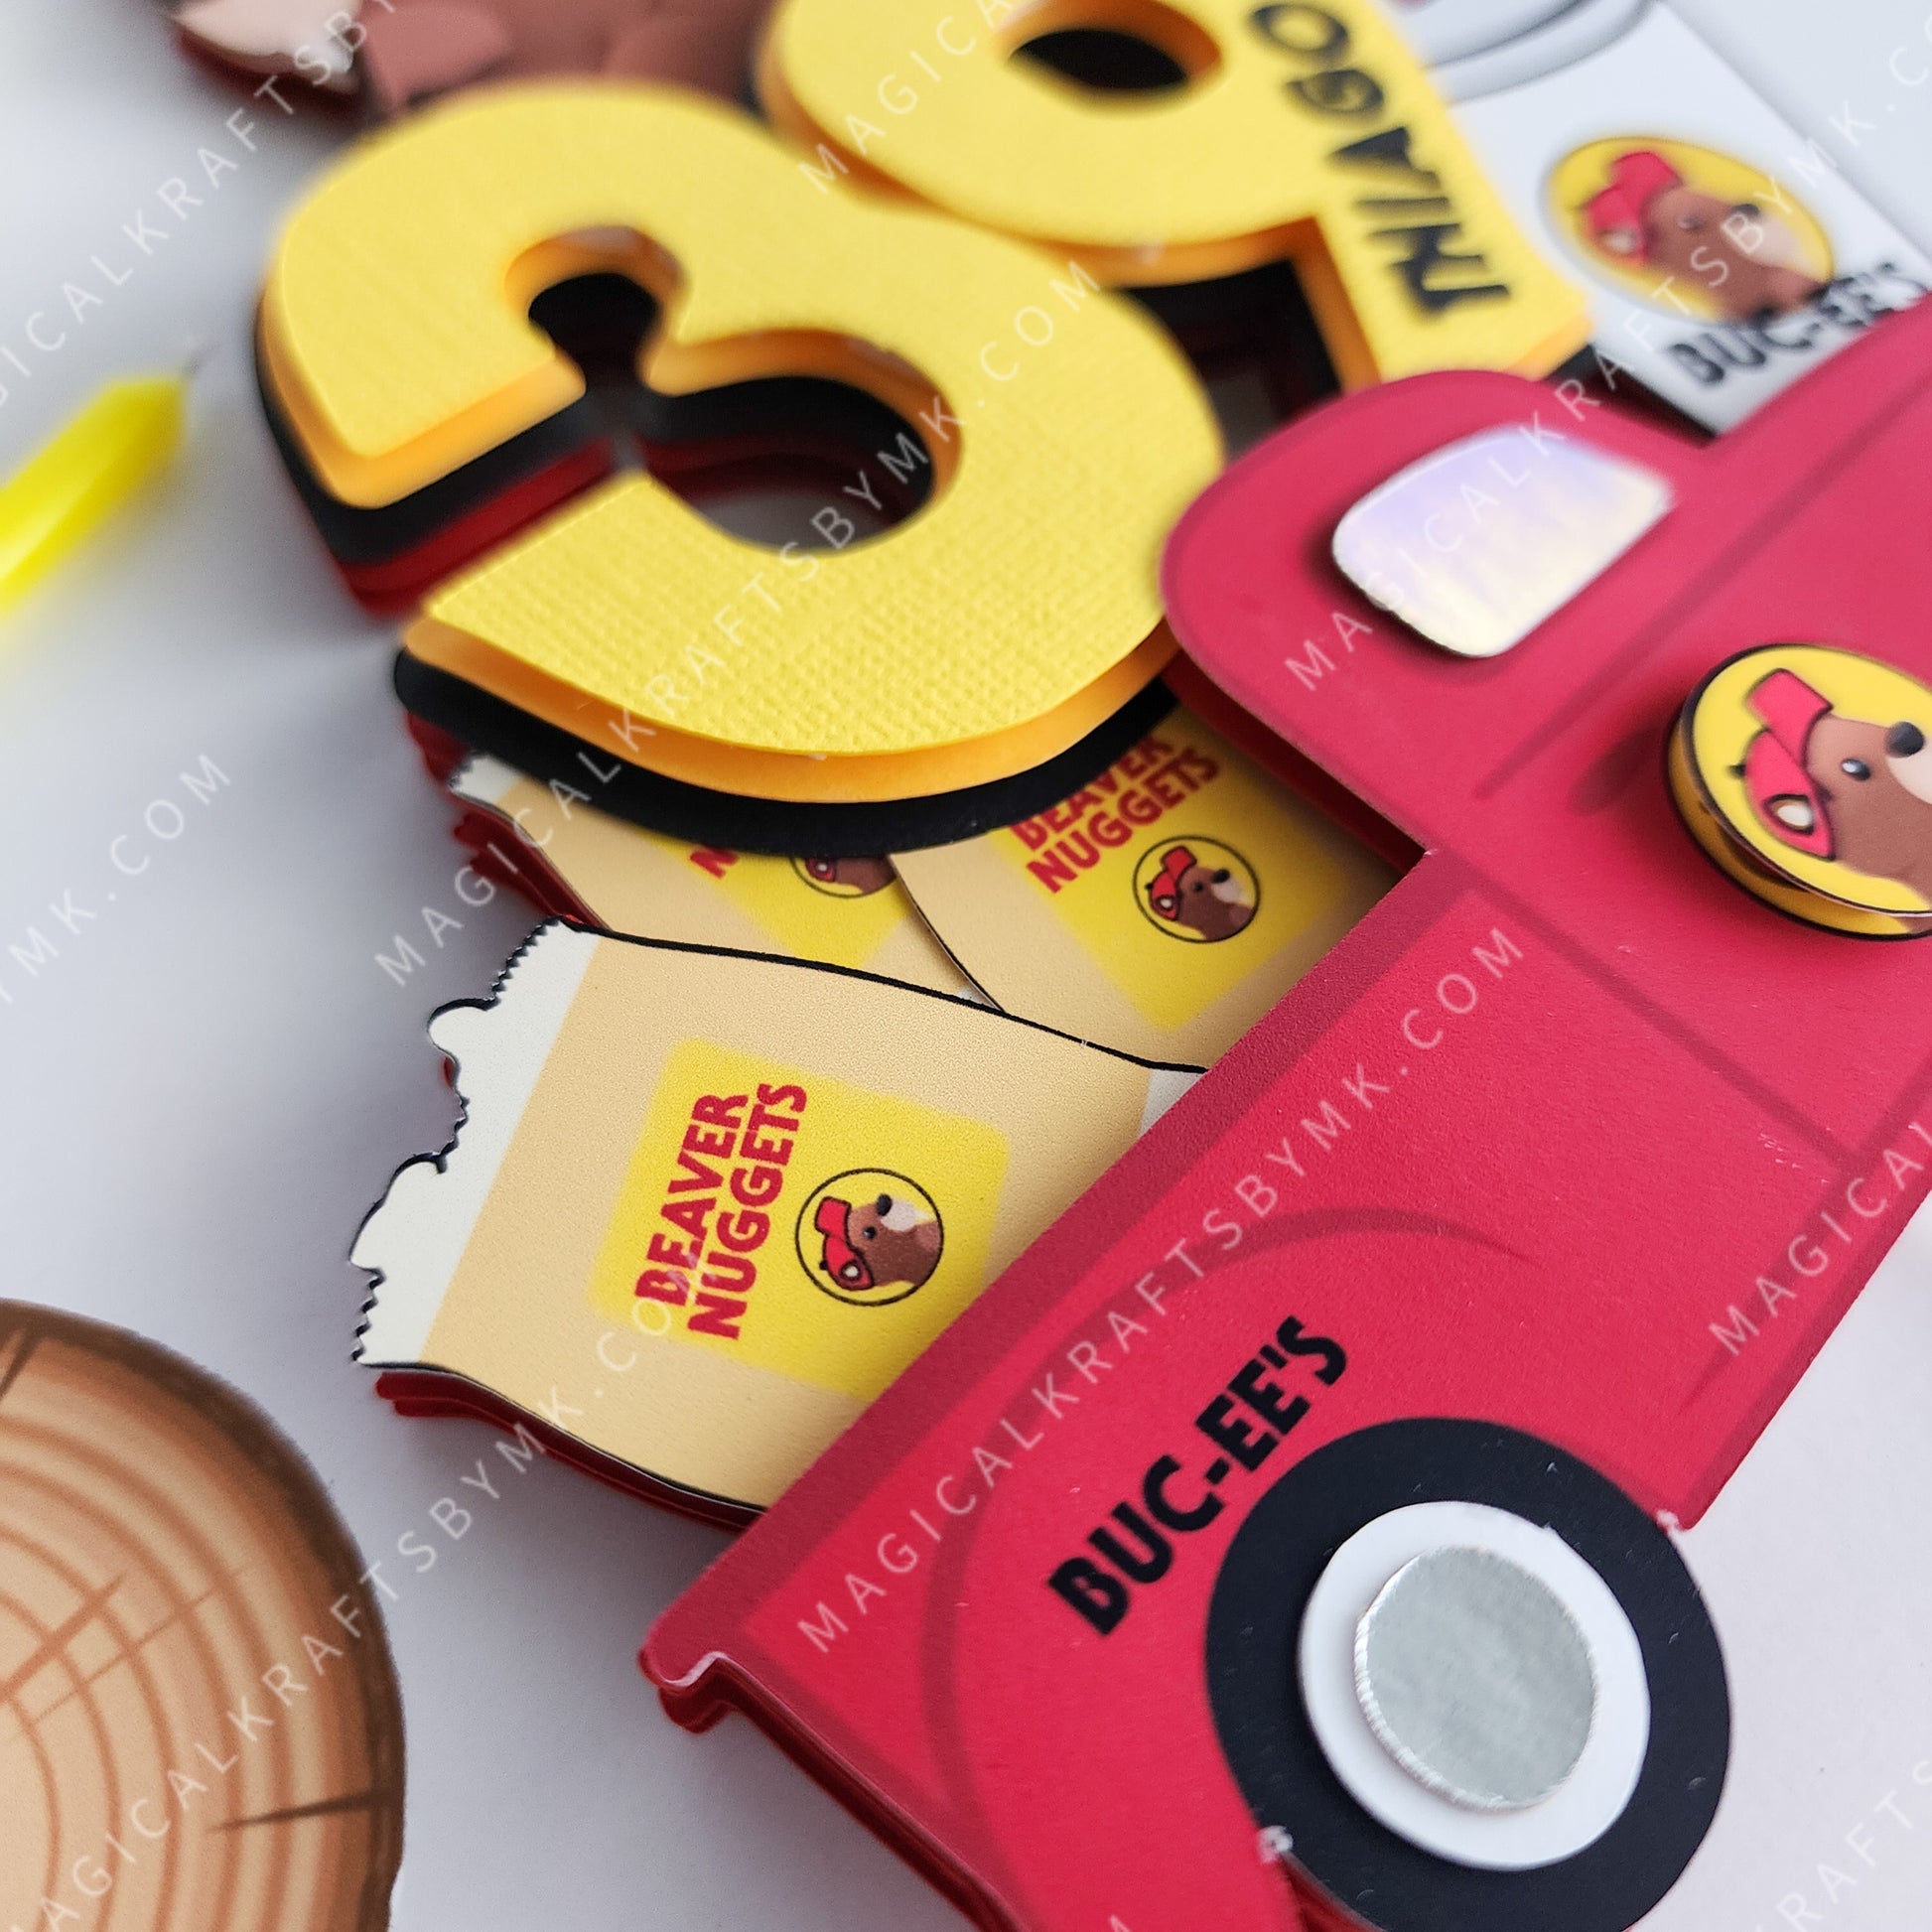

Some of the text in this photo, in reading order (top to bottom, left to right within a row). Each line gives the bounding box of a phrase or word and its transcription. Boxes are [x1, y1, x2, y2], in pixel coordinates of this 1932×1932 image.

[1245, 3, 1510, 318] THIAGO
[1027, 748, 1219, 894] NUGGETS
[634, 1094, 749, 1307] BEAVER
[687, 1083, 808, 1340] NUGGETS
[1048, 1315, 1347, 1636] BUC-EE'S
